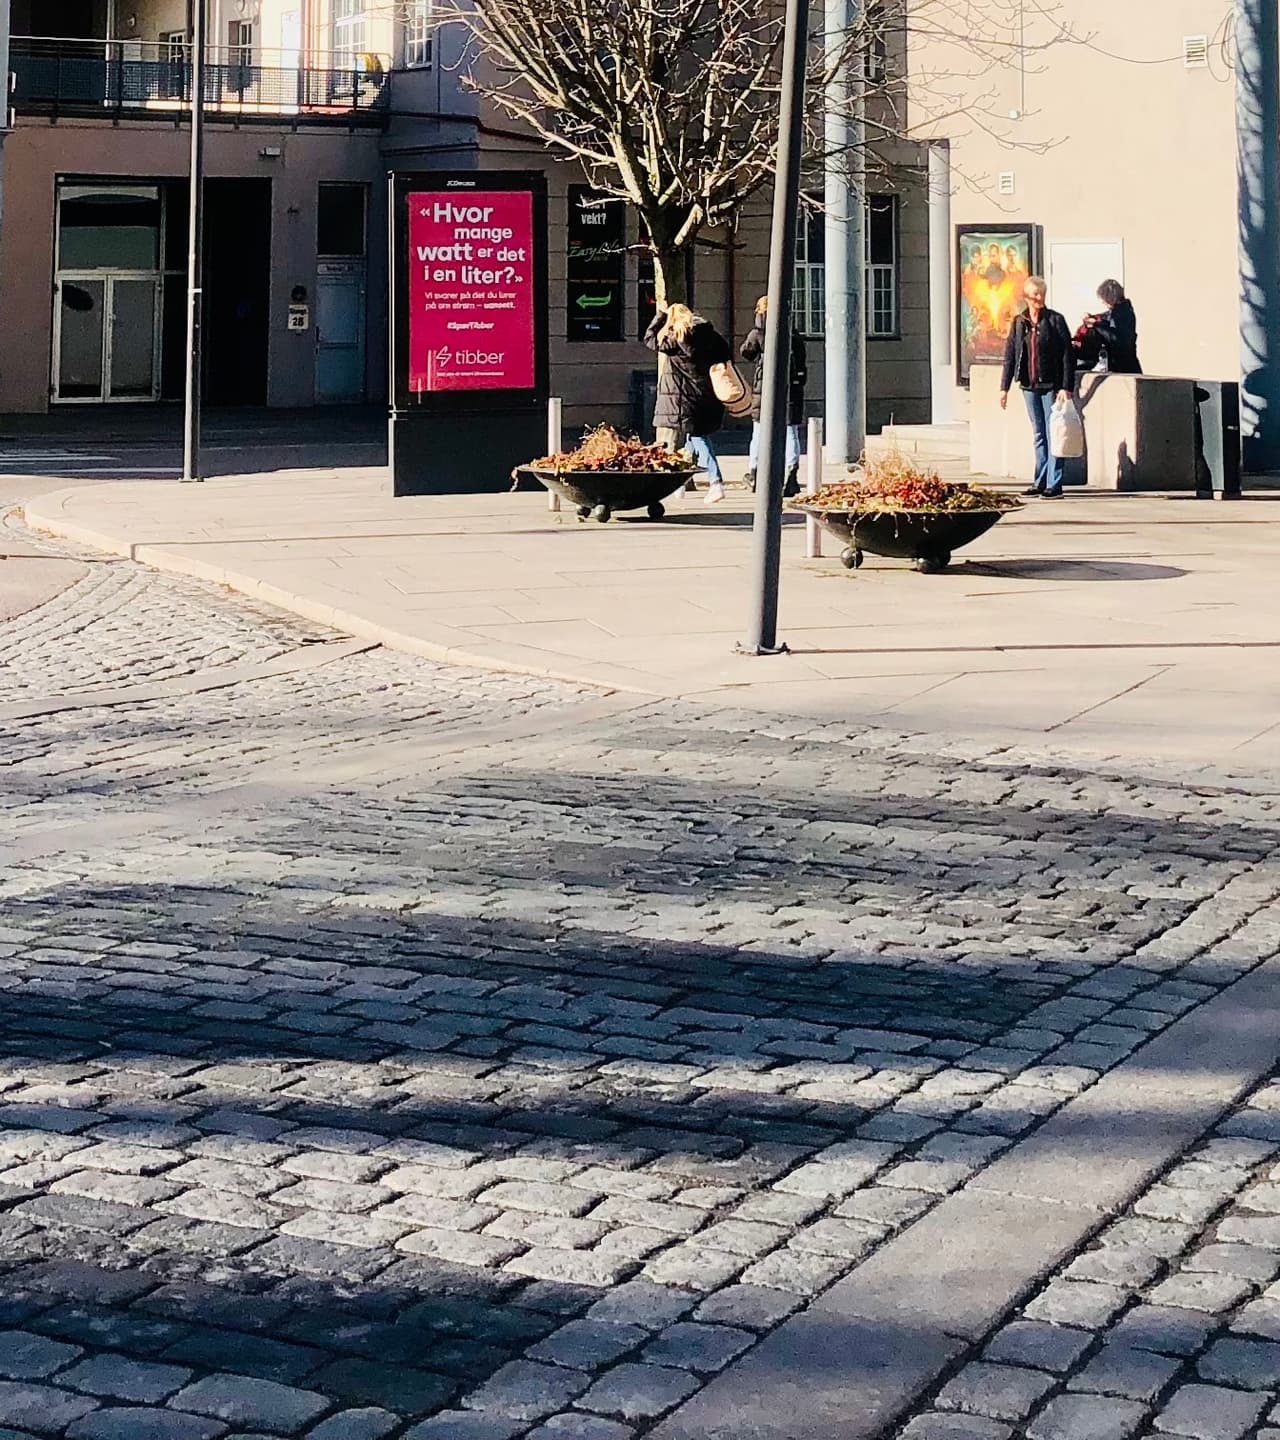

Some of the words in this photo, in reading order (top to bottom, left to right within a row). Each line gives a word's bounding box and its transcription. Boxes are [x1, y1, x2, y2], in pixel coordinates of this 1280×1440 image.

[581, 212, 607, 225] vekt?
[454, 227, 513, 243] mange
[417, 243, 473, 261] watt
[478, 247, 494, 258] er
[496, 246, 526, 261] det
[424, 265, 429, 280] i
[433, 269, 456, 282] en
[455, 349, 505, 364] tibber
